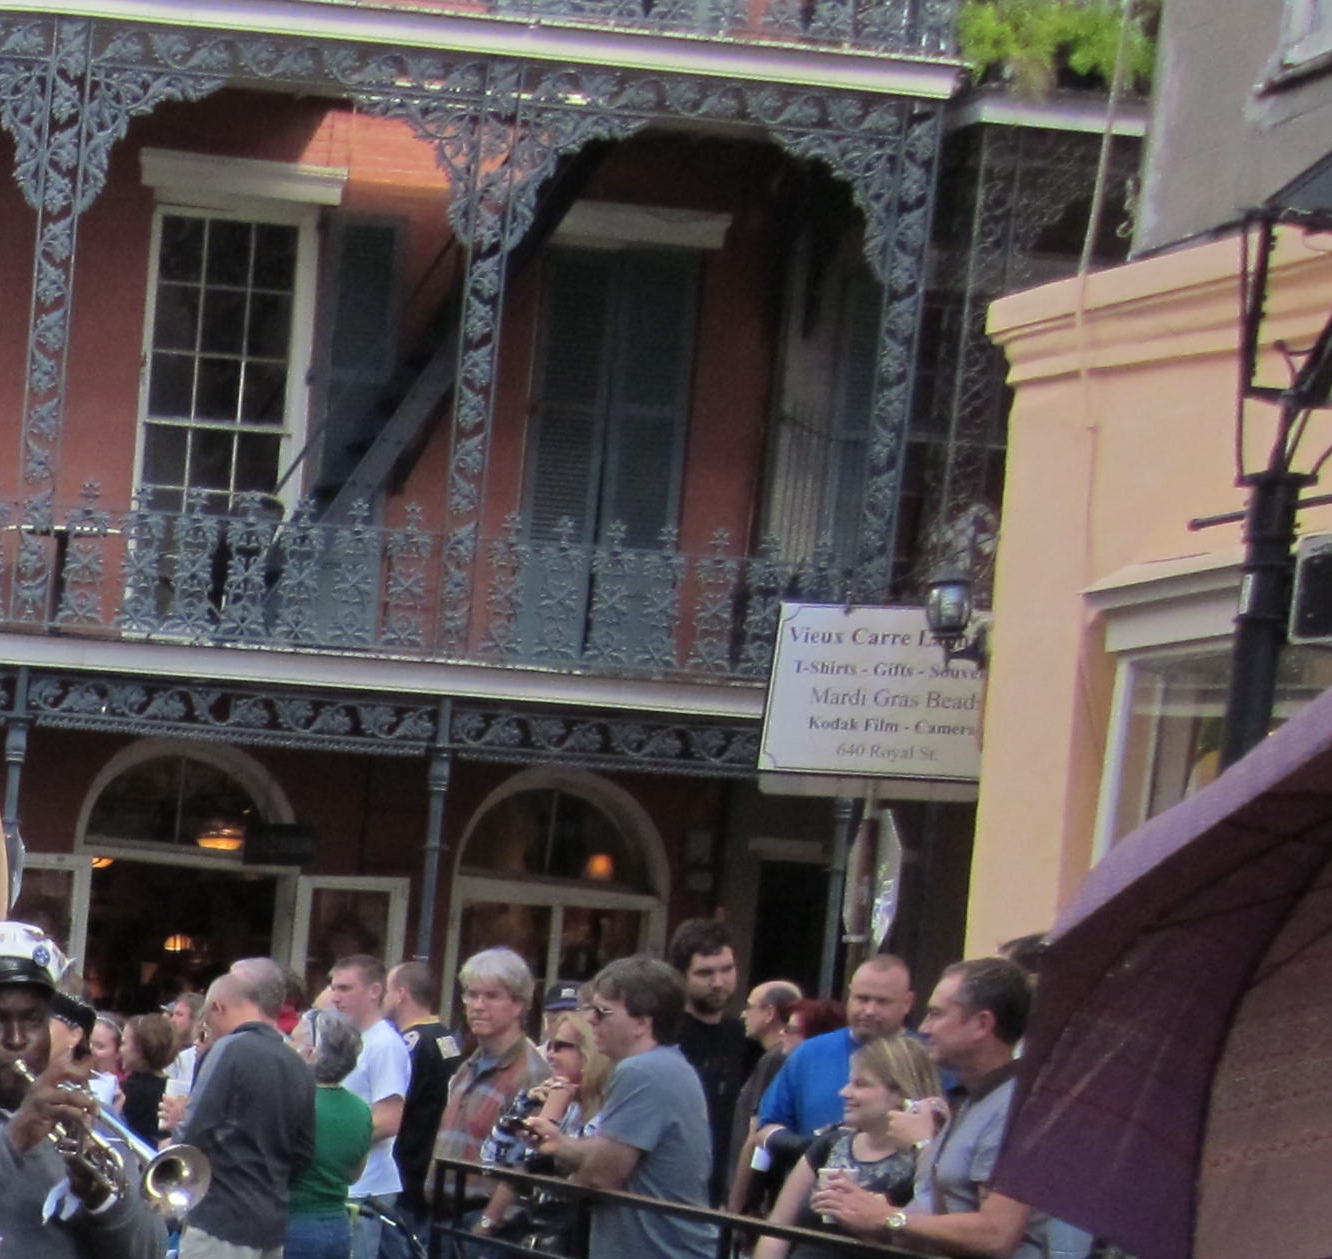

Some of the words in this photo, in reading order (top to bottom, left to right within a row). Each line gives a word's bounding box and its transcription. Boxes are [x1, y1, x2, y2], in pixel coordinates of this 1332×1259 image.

[790, 626, 843, 645] Vieux
[852, 627, 915, 646] Carre
[794, 660, 856, 676] T-Shirts
[873, 662, 913, 677] Gifts
[810, 687, 866, 707] Mardi
[874, 688, 919, 708] Gras
[926, 690, 980, 710] Bead
[808, 716, 858, 732] Kodak
[864, 718, 899, 733] Film
[836, 743, 865, 757] 640
[869, 745, 914, 762] Royal
